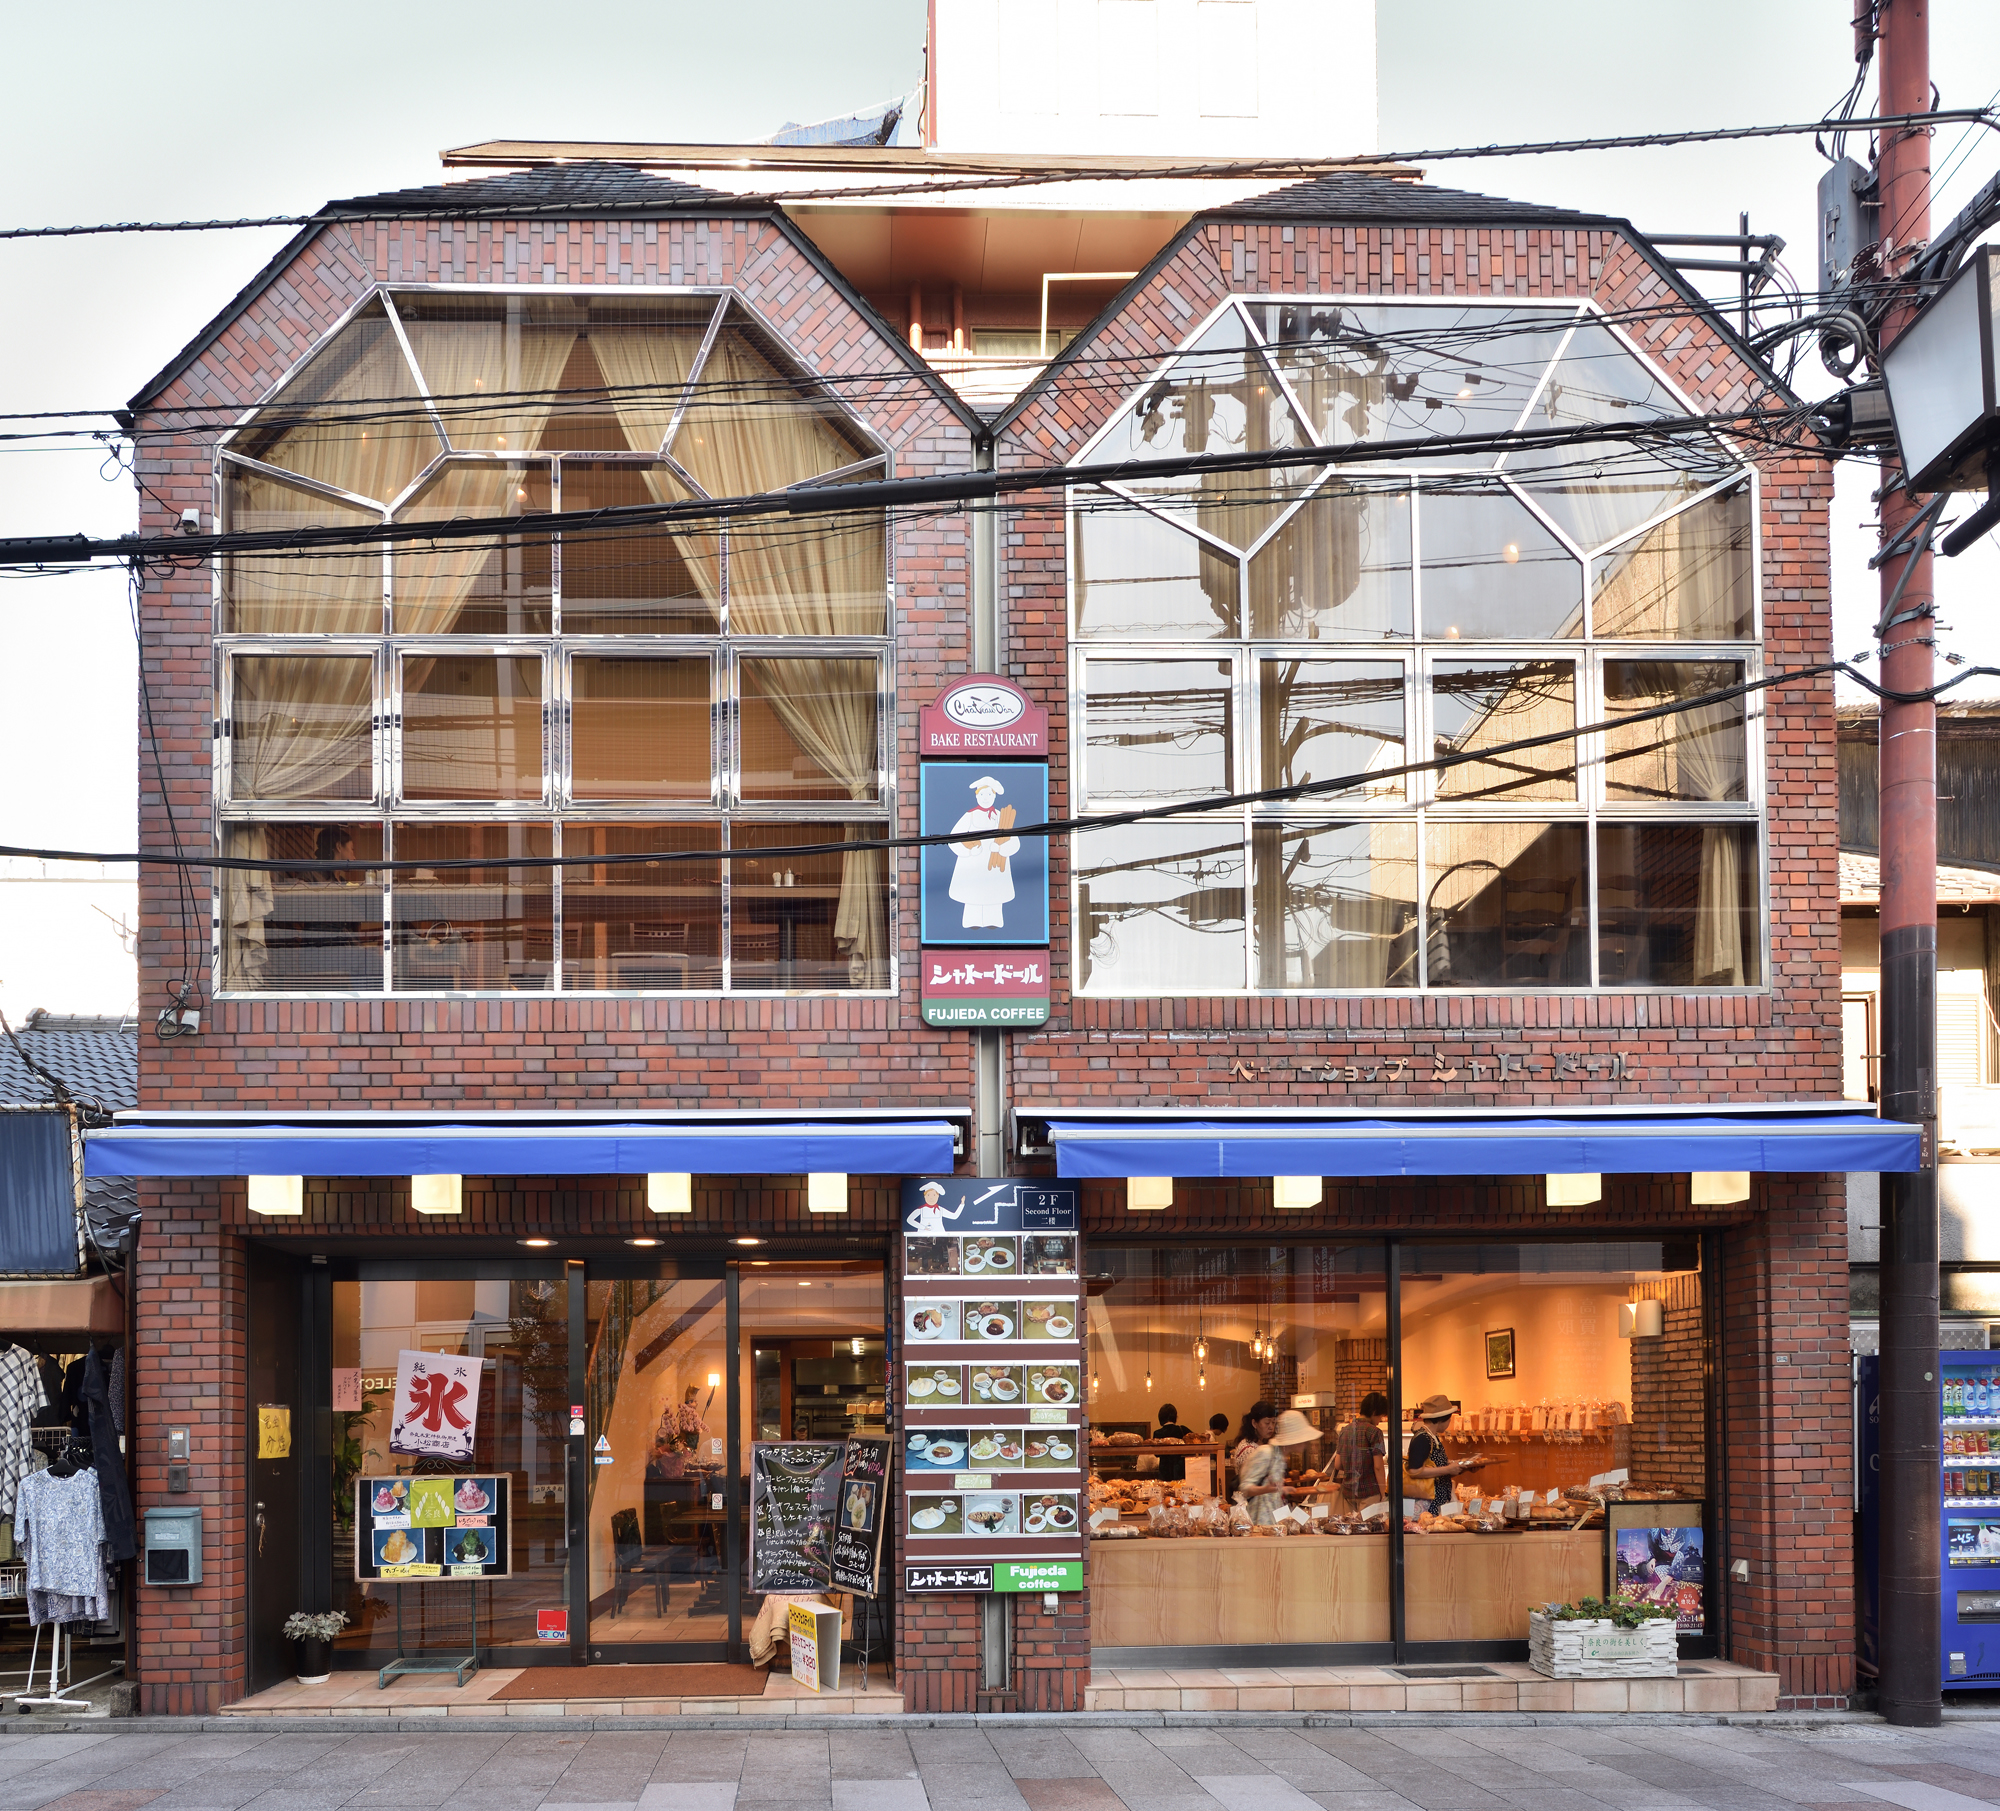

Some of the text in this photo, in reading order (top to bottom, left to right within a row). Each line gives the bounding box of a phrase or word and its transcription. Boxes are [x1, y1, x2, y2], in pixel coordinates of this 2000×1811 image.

[931, 733, 1038, 747] BAKE RESTAURANT
[929, 963, 1043, 985] シャトードール
[928, 1008, 1045, 1020] FUJIEDA COFFEE
[1431, 1051, 1635, 1082] シャトードール
[1025, 1207, 1072, 1215] Second Floor
[404, 1373, 472, 1432] 氷
[911, 1570, 989, 1587] シャトードール
[1010, 1565, 1067, 1579] Fujieda
[1018, 1579, 1059, 1589] coffee
[538, 1631, 565, 1639] SECOM
[1588, 1637, 1644, 1647] 奈良の街を美しく
